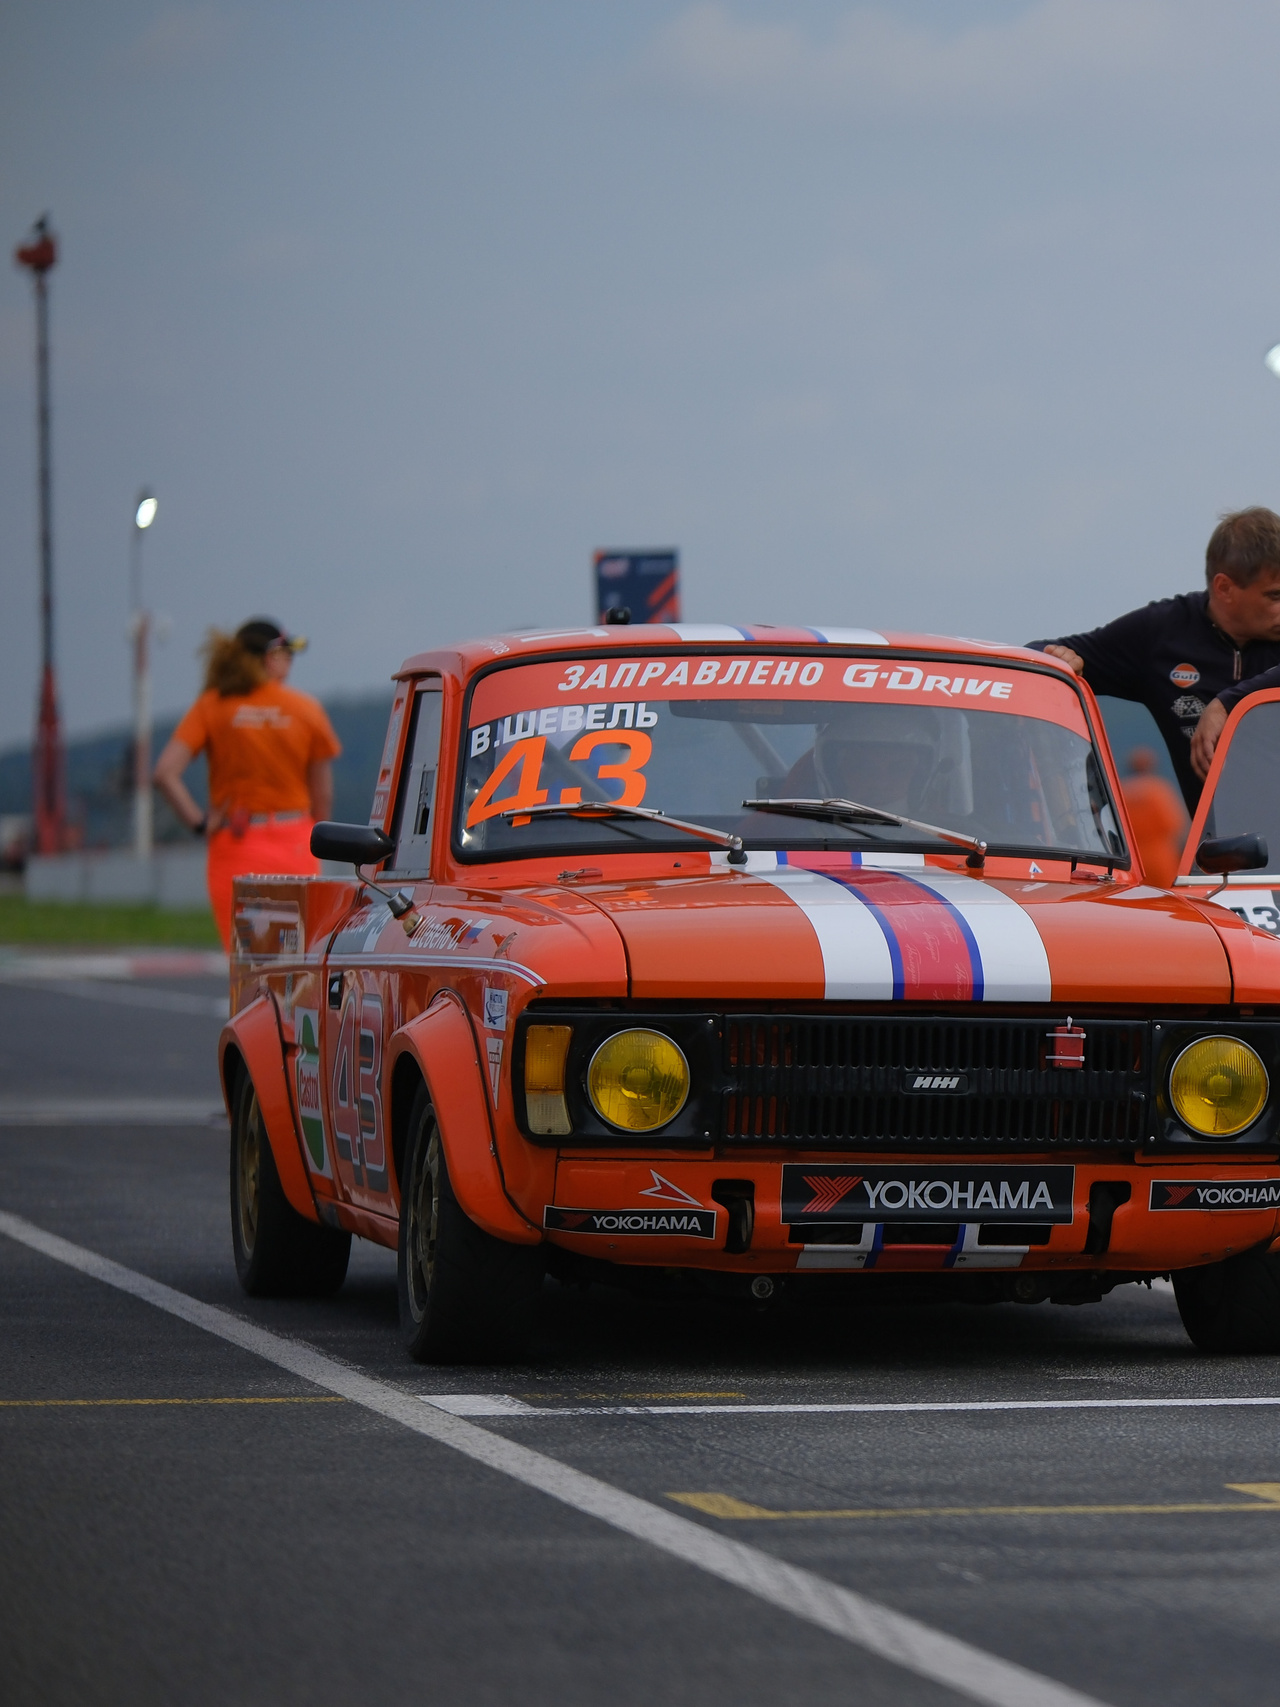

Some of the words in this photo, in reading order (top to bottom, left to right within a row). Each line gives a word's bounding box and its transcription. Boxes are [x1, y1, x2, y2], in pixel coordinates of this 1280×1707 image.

[557, 660, 825, 692] ЗАПРАВЛЕНО
[1171, 671, 1200, 680] Gulf
[466, 729, 653, 829] 43
[332, 990, 388, 1193] 43
[863, 1179, 1053, 1210] YOKOHAMA
[590, 1214, 702, 1233] YOKOHAMA
